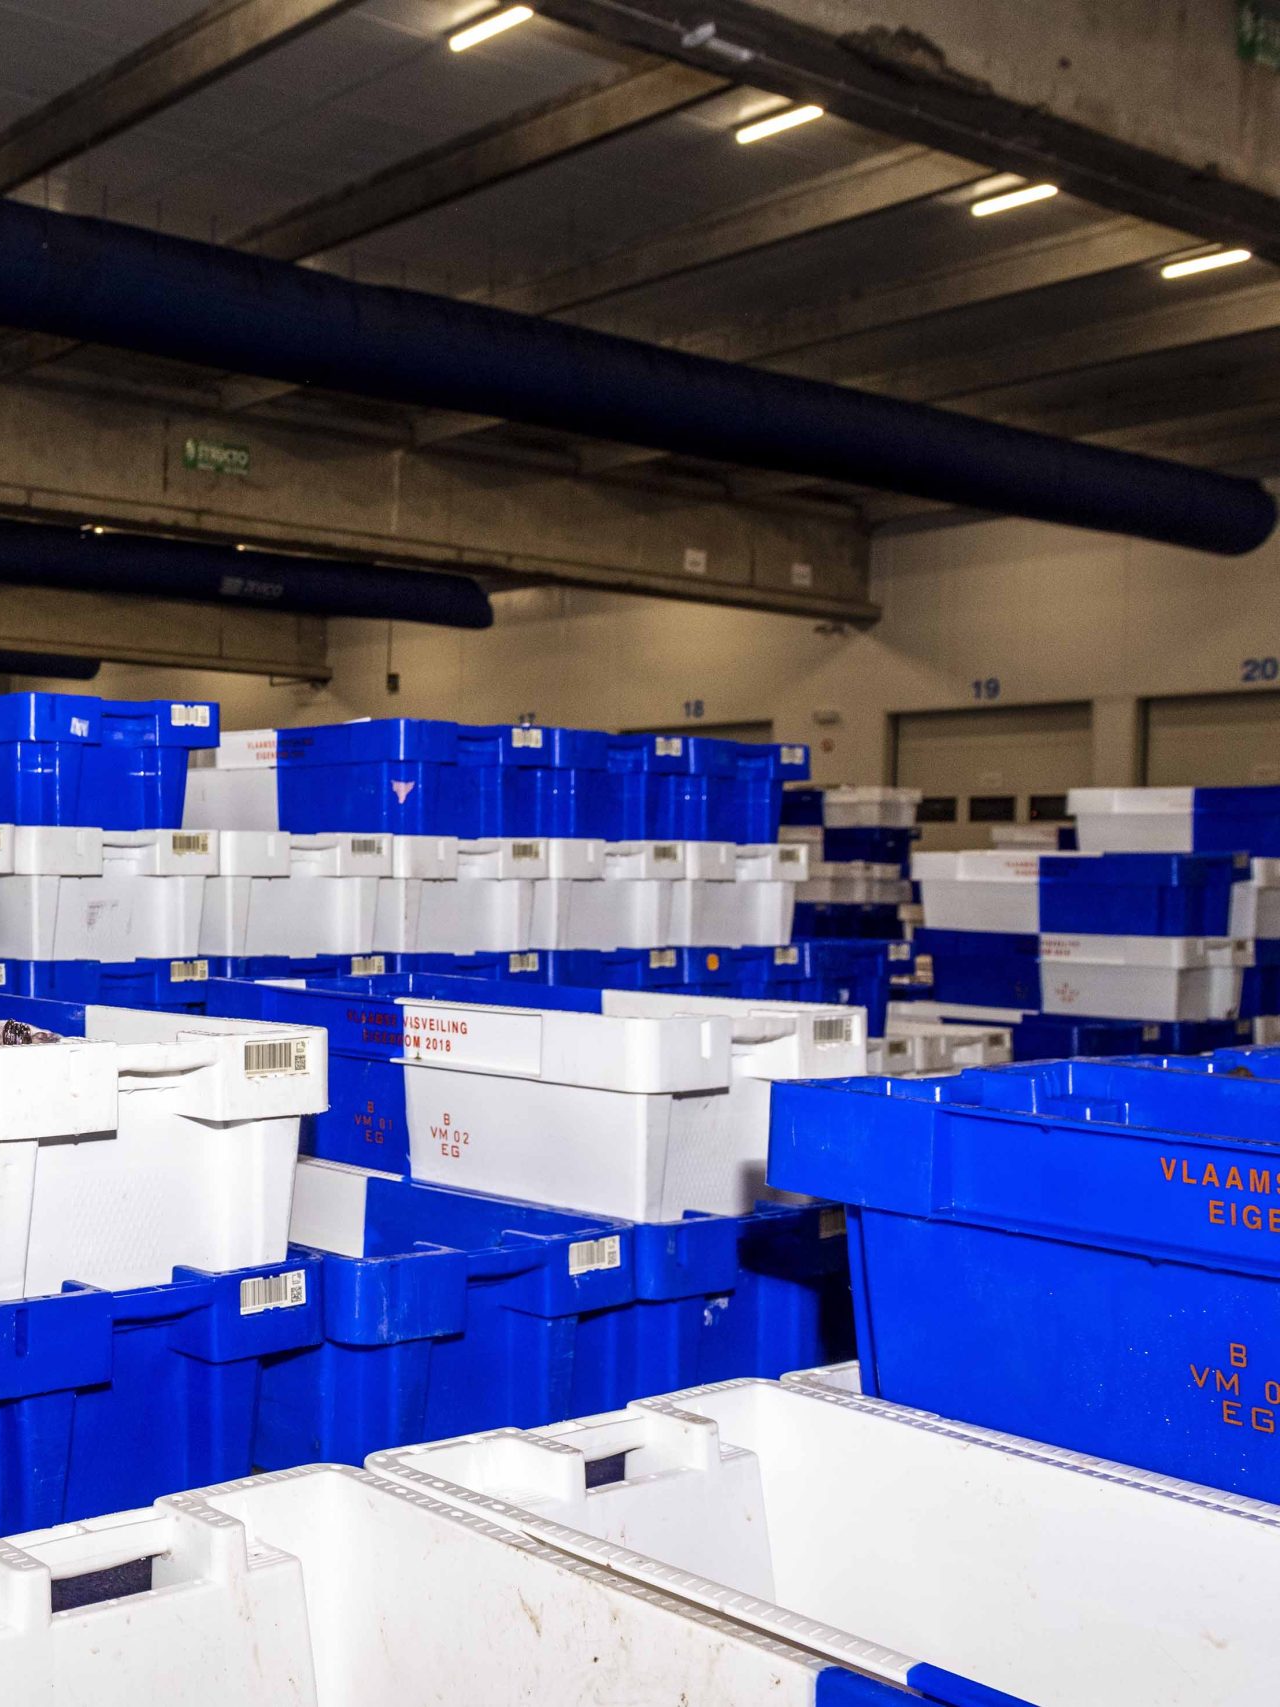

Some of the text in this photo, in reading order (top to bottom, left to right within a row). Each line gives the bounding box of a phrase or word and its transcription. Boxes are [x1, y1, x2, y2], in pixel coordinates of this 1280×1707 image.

[1241, 657, 1279, 682] 20
[971, 678, 1000, 699] 19
[684, 699, 705, 718] 18
[346, 1008, 468, 1035] VLAAMSE VISVEILING
[425, 1036, 451, 1052] 2018
[367, 1100, 374, 1114] B
[354, 1114, 372, 1127] VM
[443, 1113, 451, 1126] B
[365, 1130, 384, 1144] EG
[430, 1126, 469, 1145] VM 02
[441, 1143, 460, 1158] EG
[1160, 1157, 1280, 1195] VLAAM
[1230, 1343, 1247, 1368] B
[1190, 1364, 1239, 1396] VM
[1222, 1400, 1275, 1433] EG
